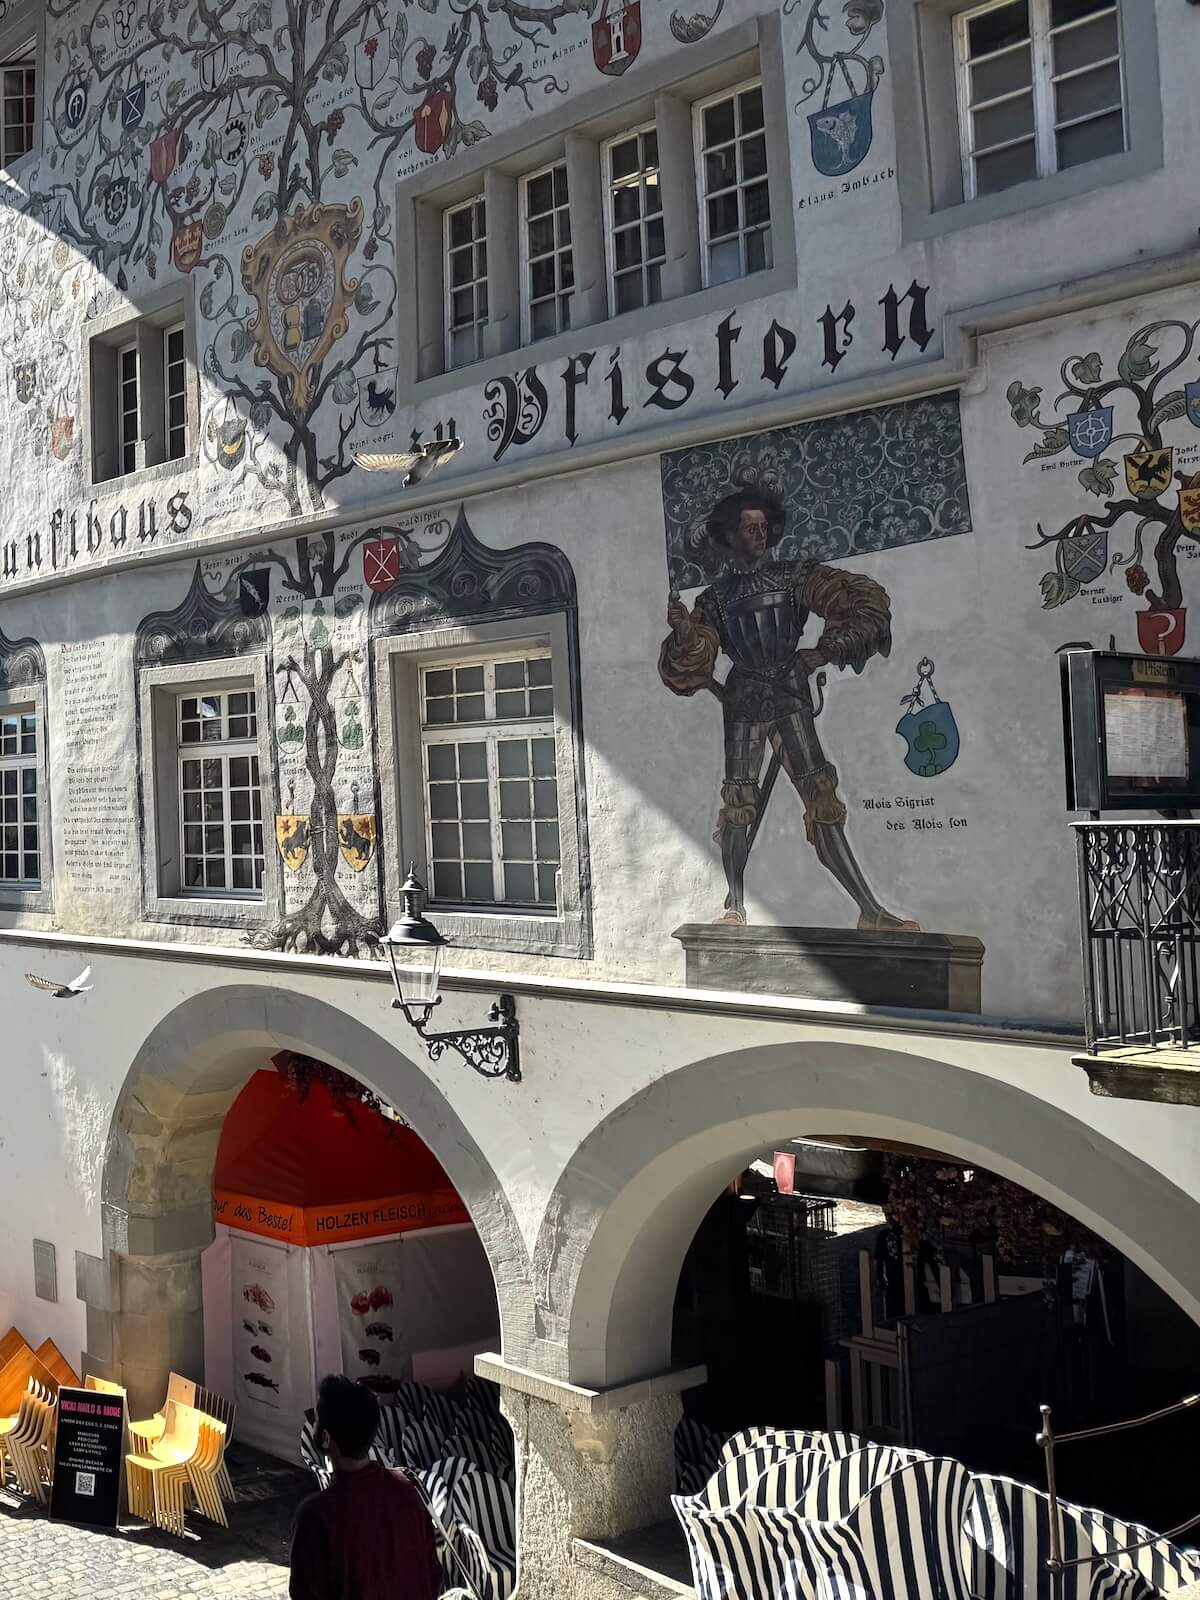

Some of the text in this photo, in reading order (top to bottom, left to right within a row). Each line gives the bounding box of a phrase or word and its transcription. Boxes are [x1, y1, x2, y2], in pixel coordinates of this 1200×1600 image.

[483, 280, 935, 461] Pfistern
[862, 796, 935, 809] Alois Sigrist
[912, 818, 943, 830] Alois
[234, 1201, 252, 1221] das
[258, 1205, 293, 1232] Beste!
[316, 1211, 369, 1231] HOLZEN
[372, 1203, 426, 1223] FLEISCH
